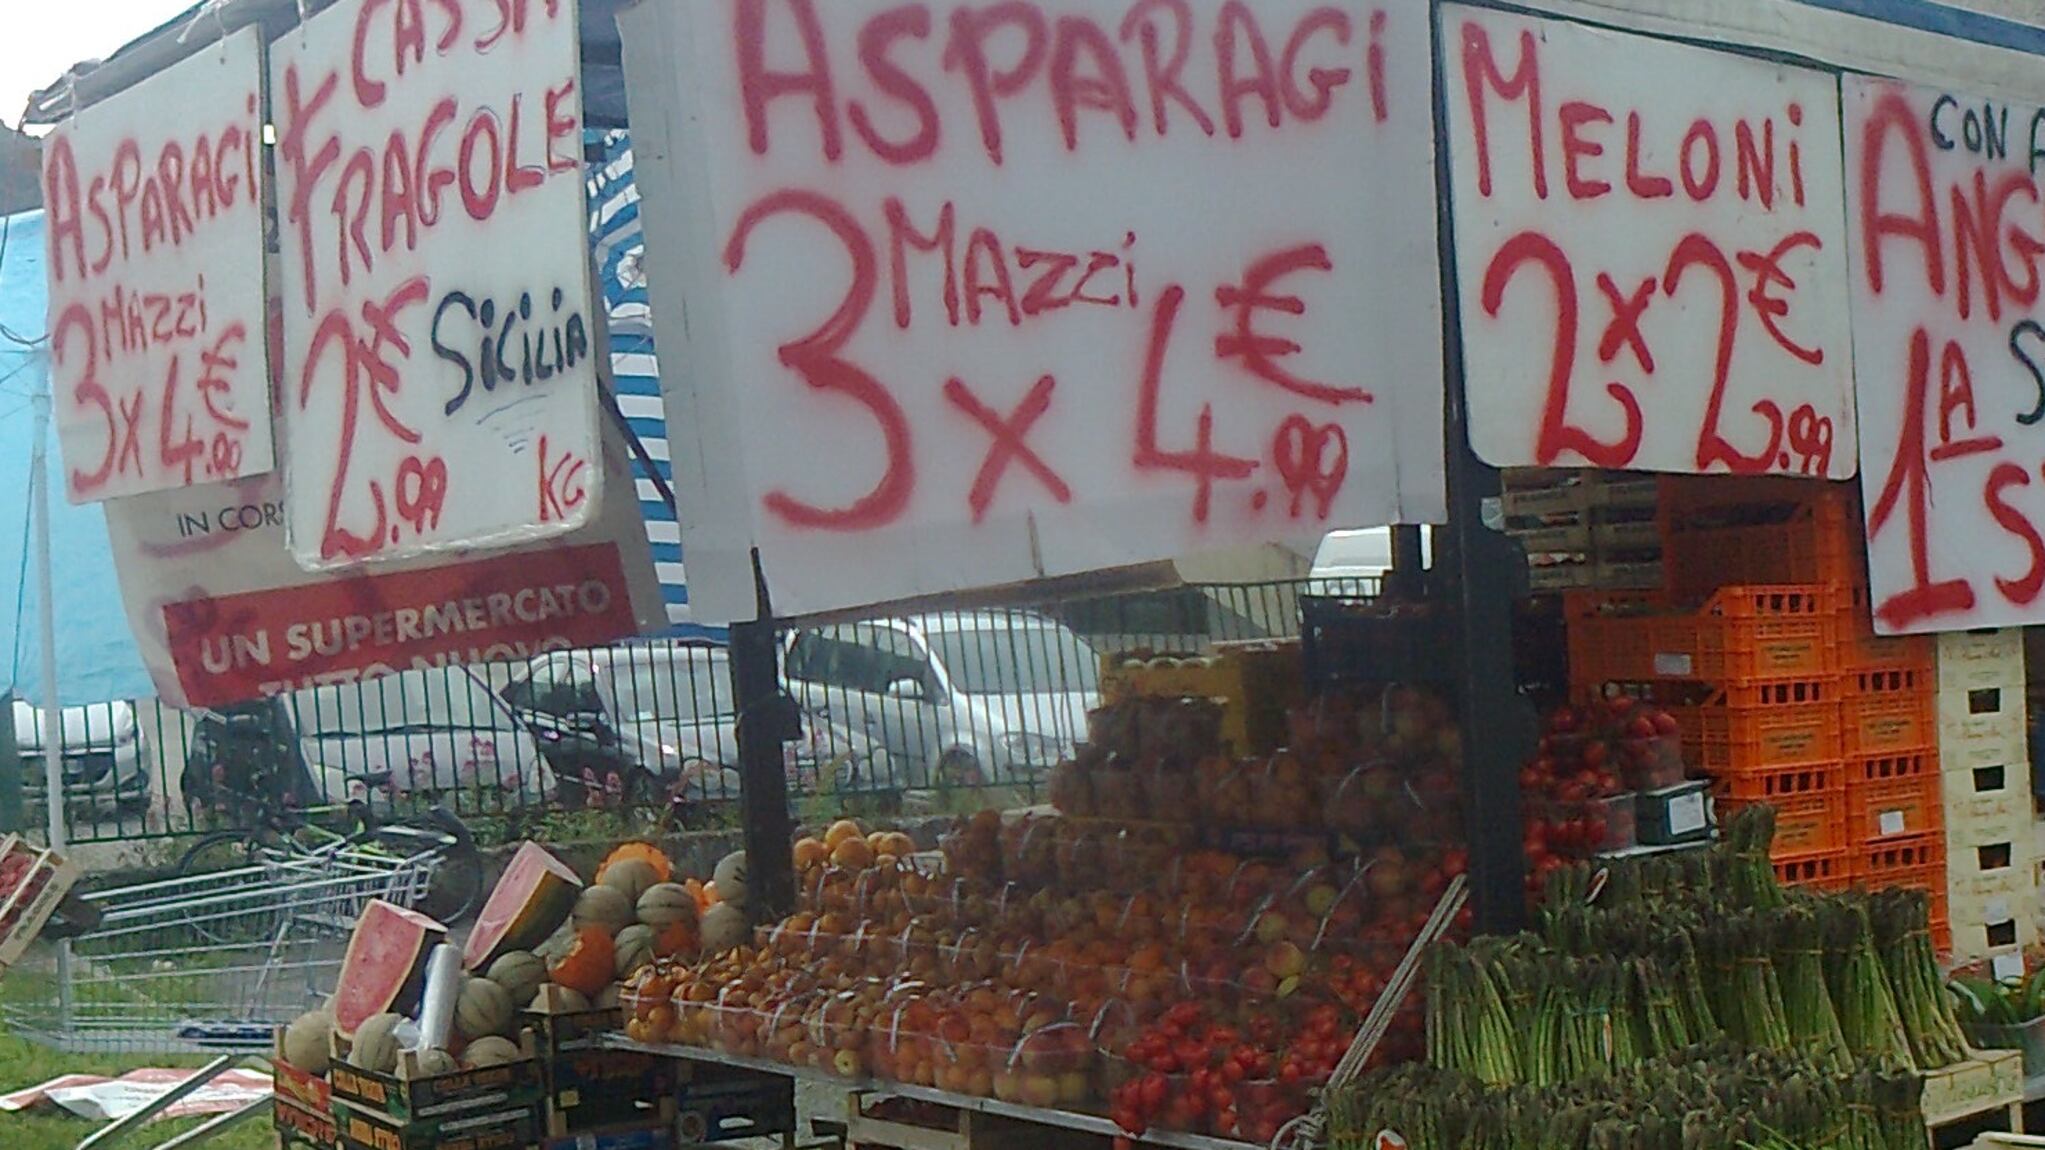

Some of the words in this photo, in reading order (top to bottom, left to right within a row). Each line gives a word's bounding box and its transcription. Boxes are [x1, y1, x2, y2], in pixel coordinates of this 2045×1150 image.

[283, 64, 578, 318] FRAGOLE
[1931, 94, 2008, 160] CON
[52, 302, 117, 493] 3
[722, 189, 916, 531] 3
[1482, 231, 1642, 468] 2
[176, 511, 211, 537] IN
[201, 629, 271, 674] UN
[286, 578, 611, 662] SUPERMERCATO
